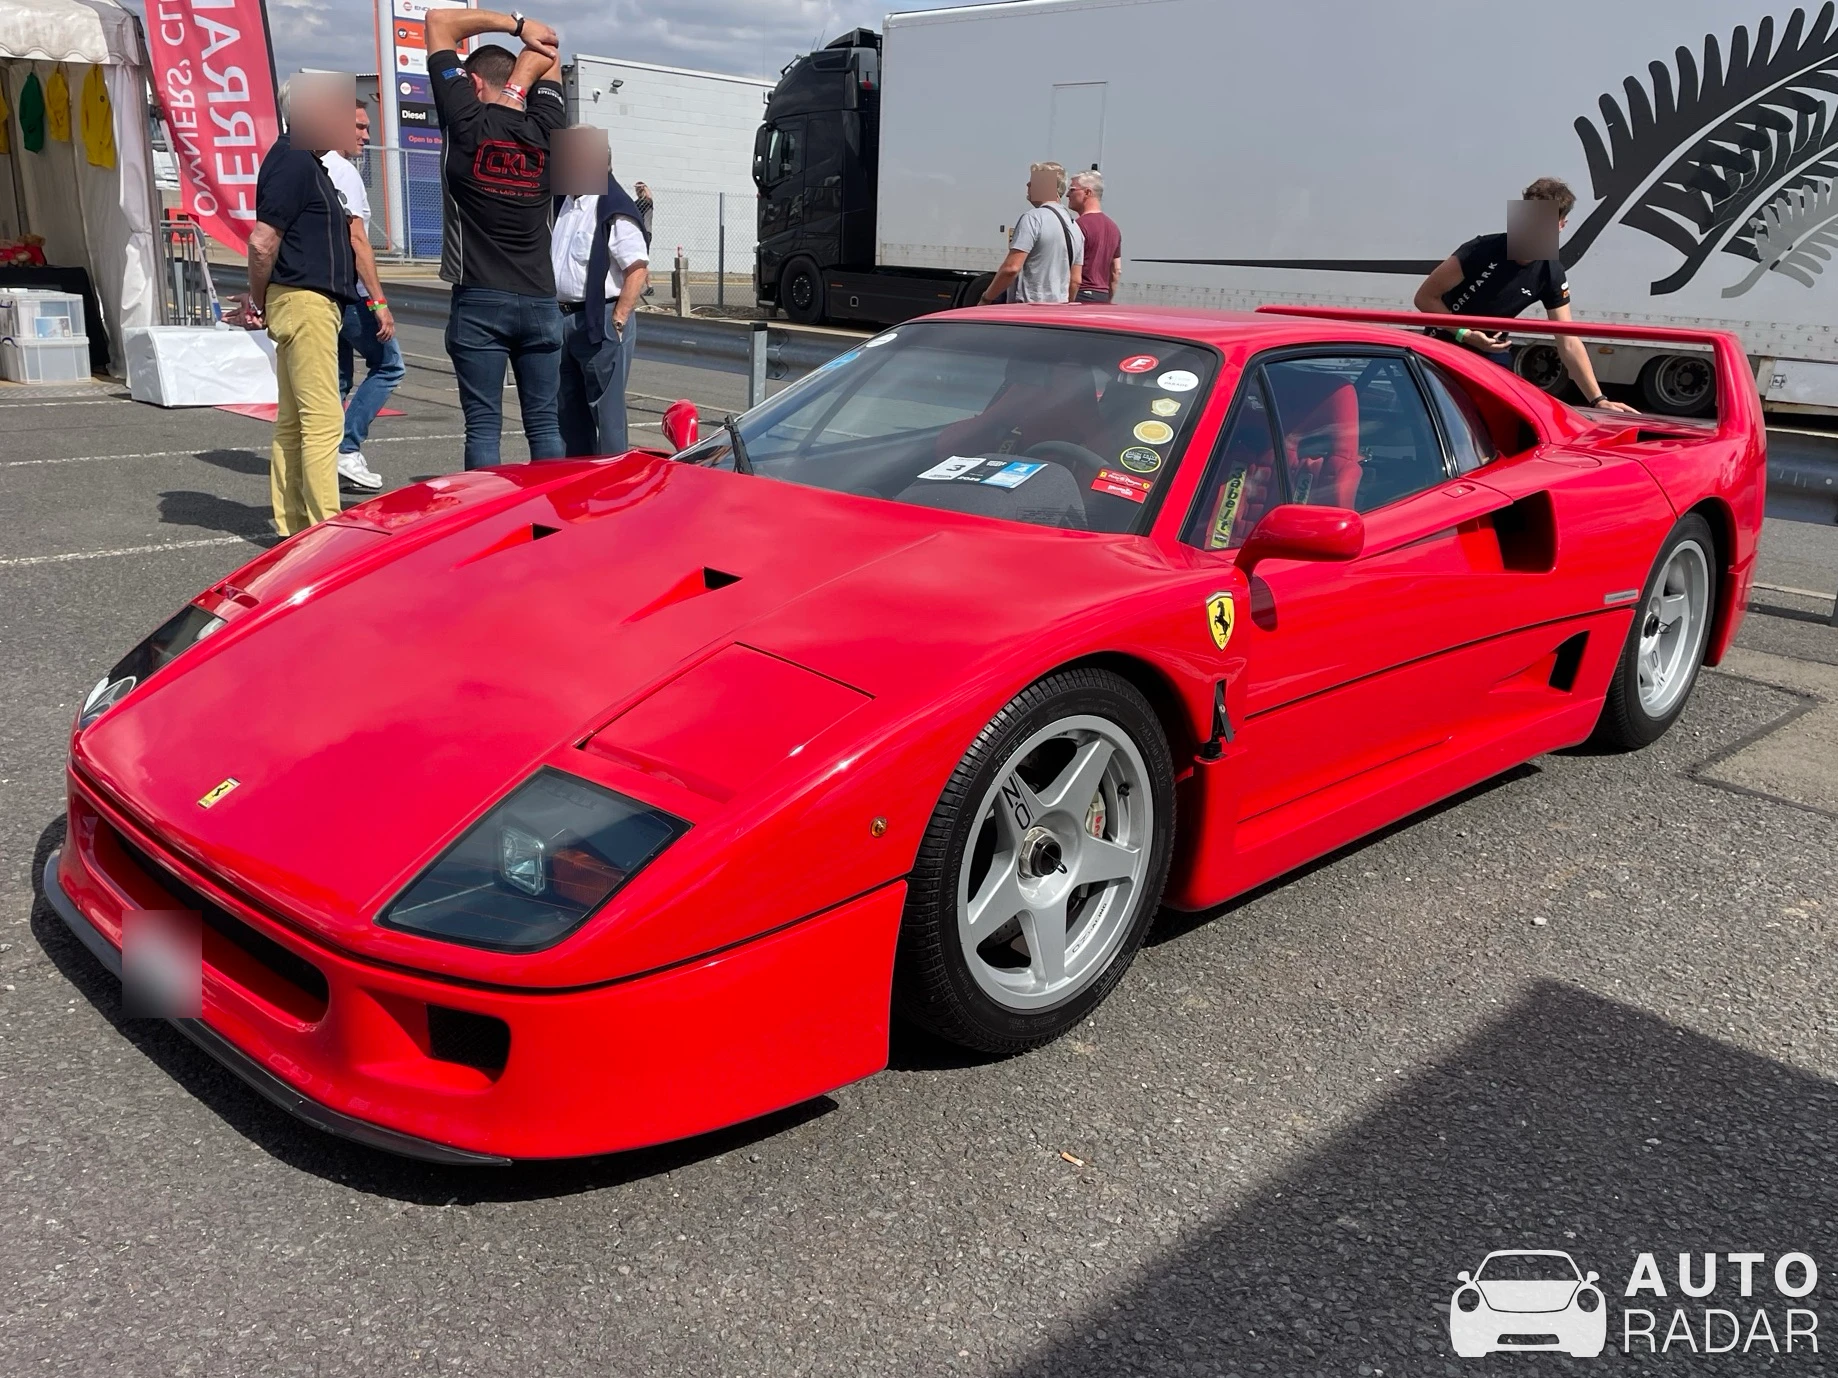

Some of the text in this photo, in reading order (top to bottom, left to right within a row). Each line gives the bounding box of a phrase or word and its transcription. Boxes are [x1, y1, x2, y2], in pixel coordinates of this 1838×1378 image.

[401, 109, 426, 120] Diesel
[408, 135, 426, 143] Open
[1469, 261, 1498, 293] PARK
[945, 464, 967, 472] 3
